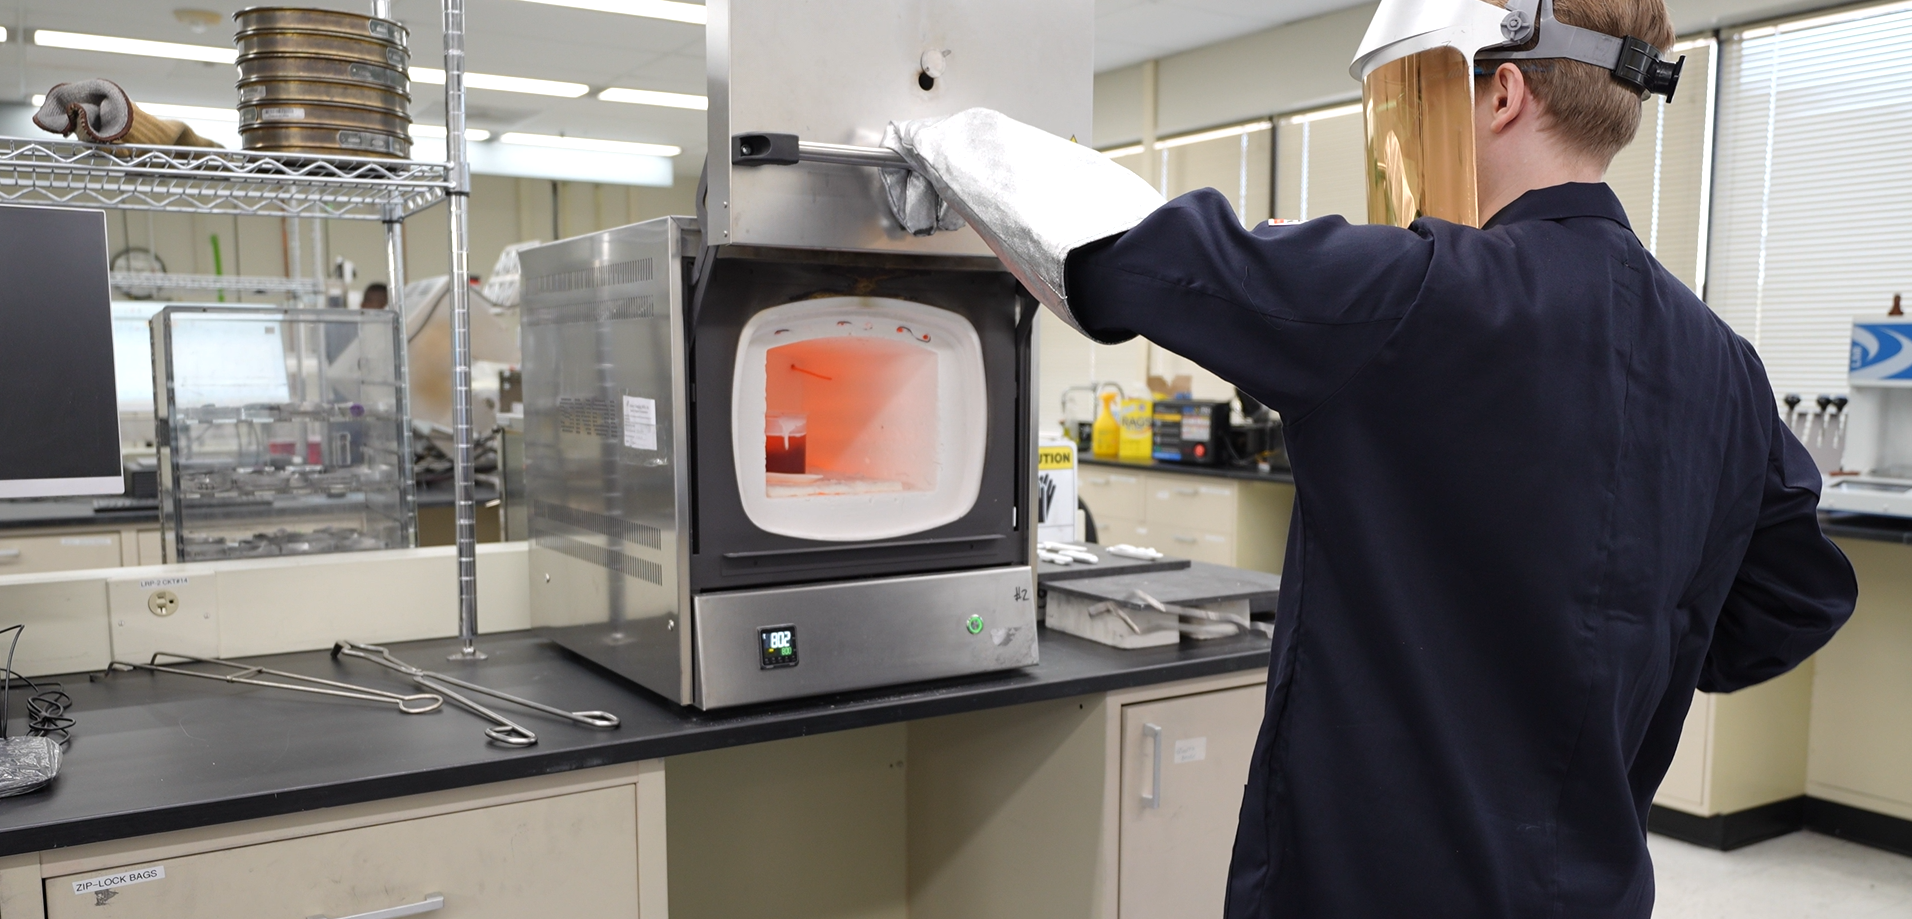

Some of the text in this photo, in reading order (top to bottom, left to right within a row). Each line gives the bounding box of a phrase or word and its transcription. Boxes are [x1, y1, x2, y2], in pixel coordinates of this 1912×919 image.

[1038, 452, 1071, 464] UTION
[1013, 586, 1030, 602] #2
[770, 630, 792, 649] 802
[75, 869, 158, 892] ZIP-LOCK BAGS
